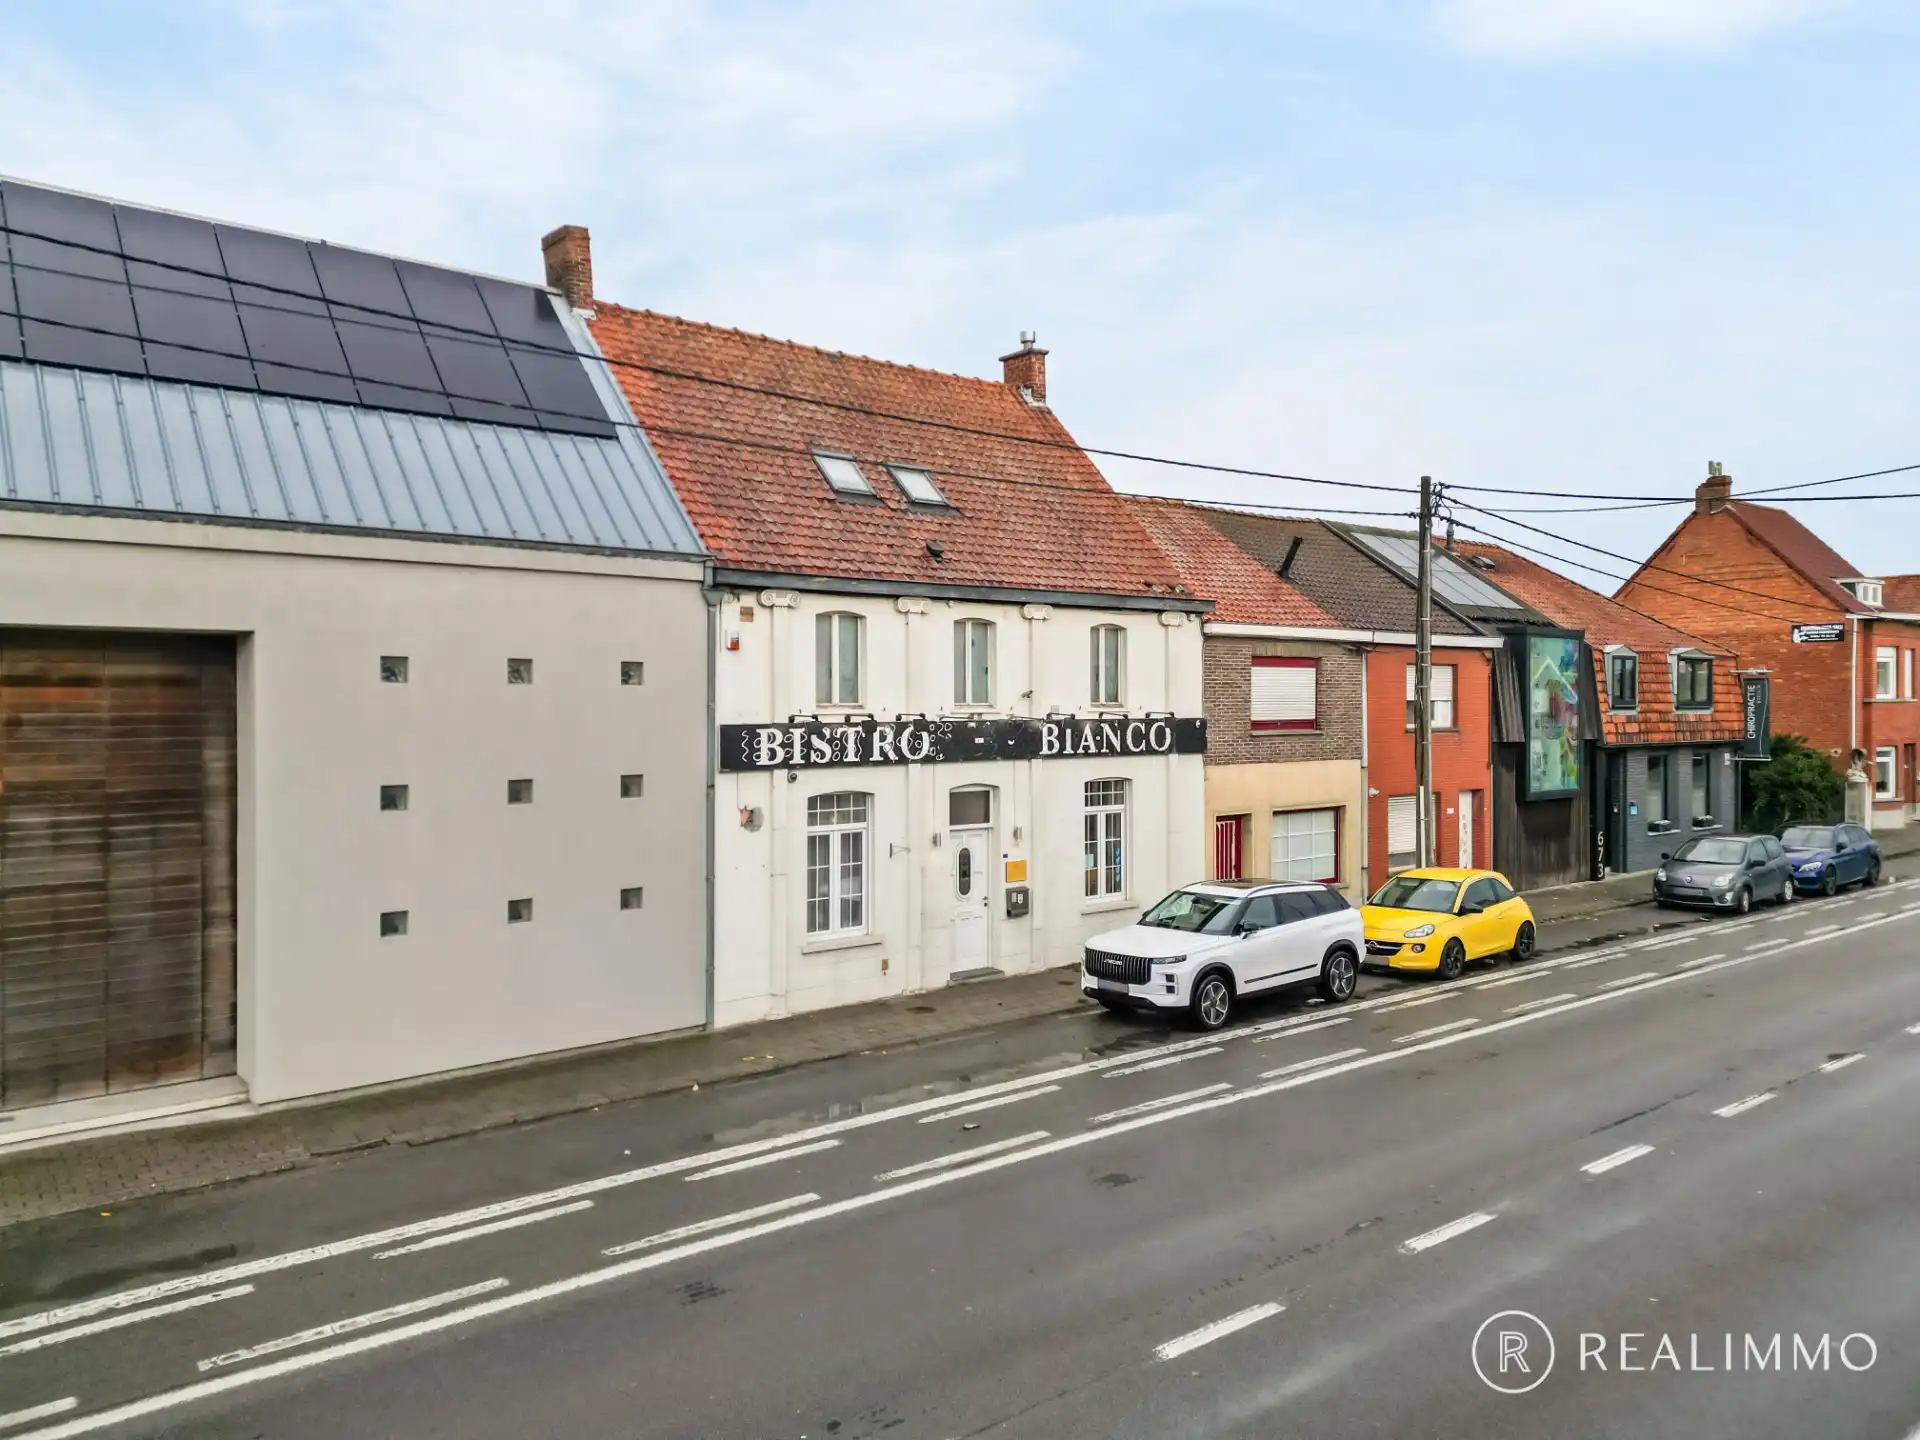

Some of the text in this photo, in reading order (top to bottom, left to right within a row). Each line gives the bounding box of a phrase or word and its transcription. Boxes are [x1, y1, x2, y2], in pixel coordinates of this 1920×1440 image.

[1747, 684, 1756, 739] CHIROPRACTIE
[755, 720, 1171, 766] BISTRO BIANCO
